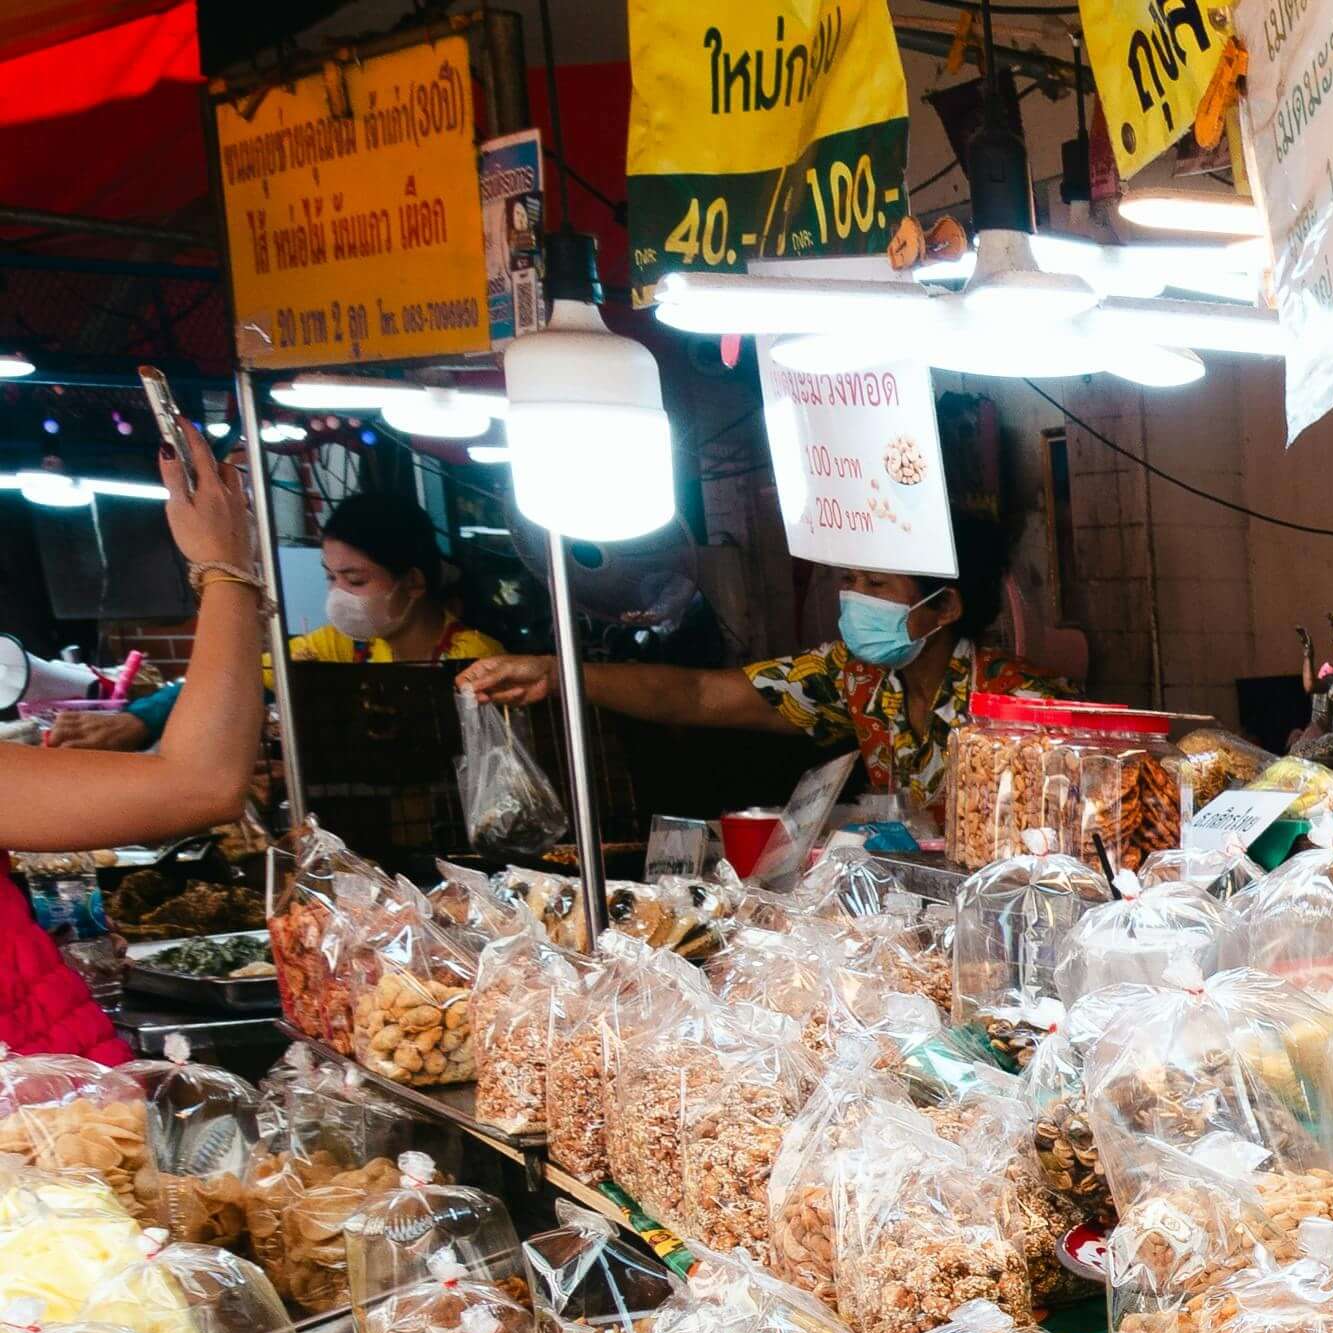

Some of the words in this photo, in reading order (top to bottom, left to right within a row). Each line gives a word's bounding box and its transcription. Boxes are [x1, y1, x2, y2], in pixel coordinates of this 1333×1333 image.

[331, 300, 343, 342] 2
[805, 445, 832, 480] 100
[835, 454, 864, 480] บาท
[815, 495, 844, 531] 200
[845, 509, 874, 534] บาท
